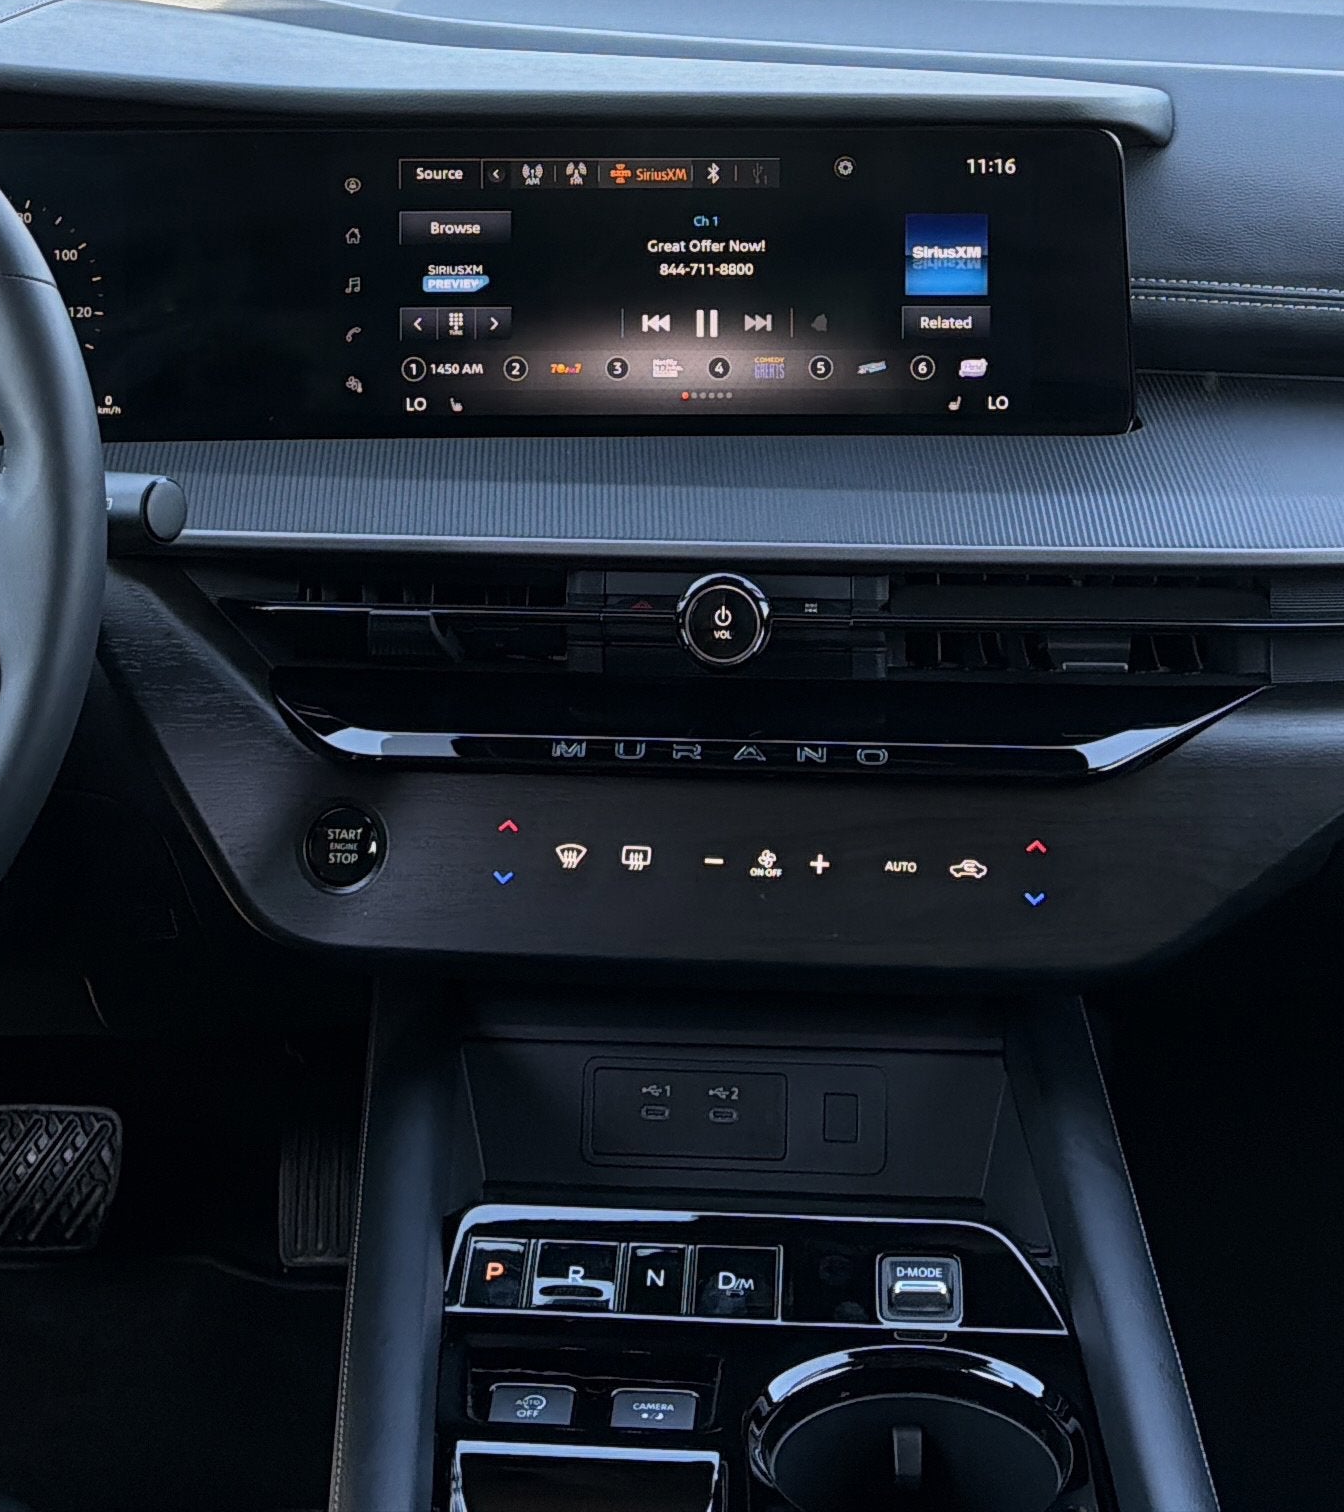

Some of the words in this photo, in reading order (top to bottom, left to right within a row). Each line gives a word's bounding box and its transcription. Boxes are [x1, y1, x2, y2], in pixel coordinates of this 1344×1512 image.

[966, 158, 1017, 175] 11:16
[416, 167, 464, 180] Source
[636, 167, 687, 182] SiriusXM
[430, 221, 481, 234] Browse
[693, 215, 709, 227] Ch
[712, 216, 718, 227] 1
[647, 239, 686, 253] Great
[689, 239, 724, 253] Offer
[729, 239, 766, 253] Now!
[912, 246, 982, 259] SiriusXM
[54, 249, 78, 261] 100
[428, 265, 484, 275] SIRIUSXM
[659, 263, 754, 276] 844-711-8800
[68, 306, 92, 318] 120
[920, 316, 972, 329] Related
[430, 363, 460, 375] 1450
[461, 363, 484, 375] AM
[511, 362, 521, 375] 2
[612, 362, 622, 375] 3
[714, 362, 723, 374] 4
[816, 361, 825, 374] 5
[918, 361, 927, 374] 6
[105, 395, 112, 405] 0
[405, 397, 427, 411] LO
[987, 395, 1009, 410] LO
[97, 405, 122, 415] km/h
[713, 630, 732, 640] VOL
[552, 740, 889, 765] MURANO
[327, 828, 364, 840] START
[329, 842, 358, 851] ENGINE
[328, 852, 359, 865] STOP
[884, 860, 918, 873] AUTO
[665, 1085, 671, 1097] 1
[731, 1087, 739, 1100] 2
[485, 1262, 504, 1281] P
[567, 1266, 586, 1283] R
[645, 1269, 666, 1287] N
[896, 1266, 944, 1278] D-MODE
[631, 1401, 675, 1412] CAMERA
[516, 1408, 540, 1419] OFF
